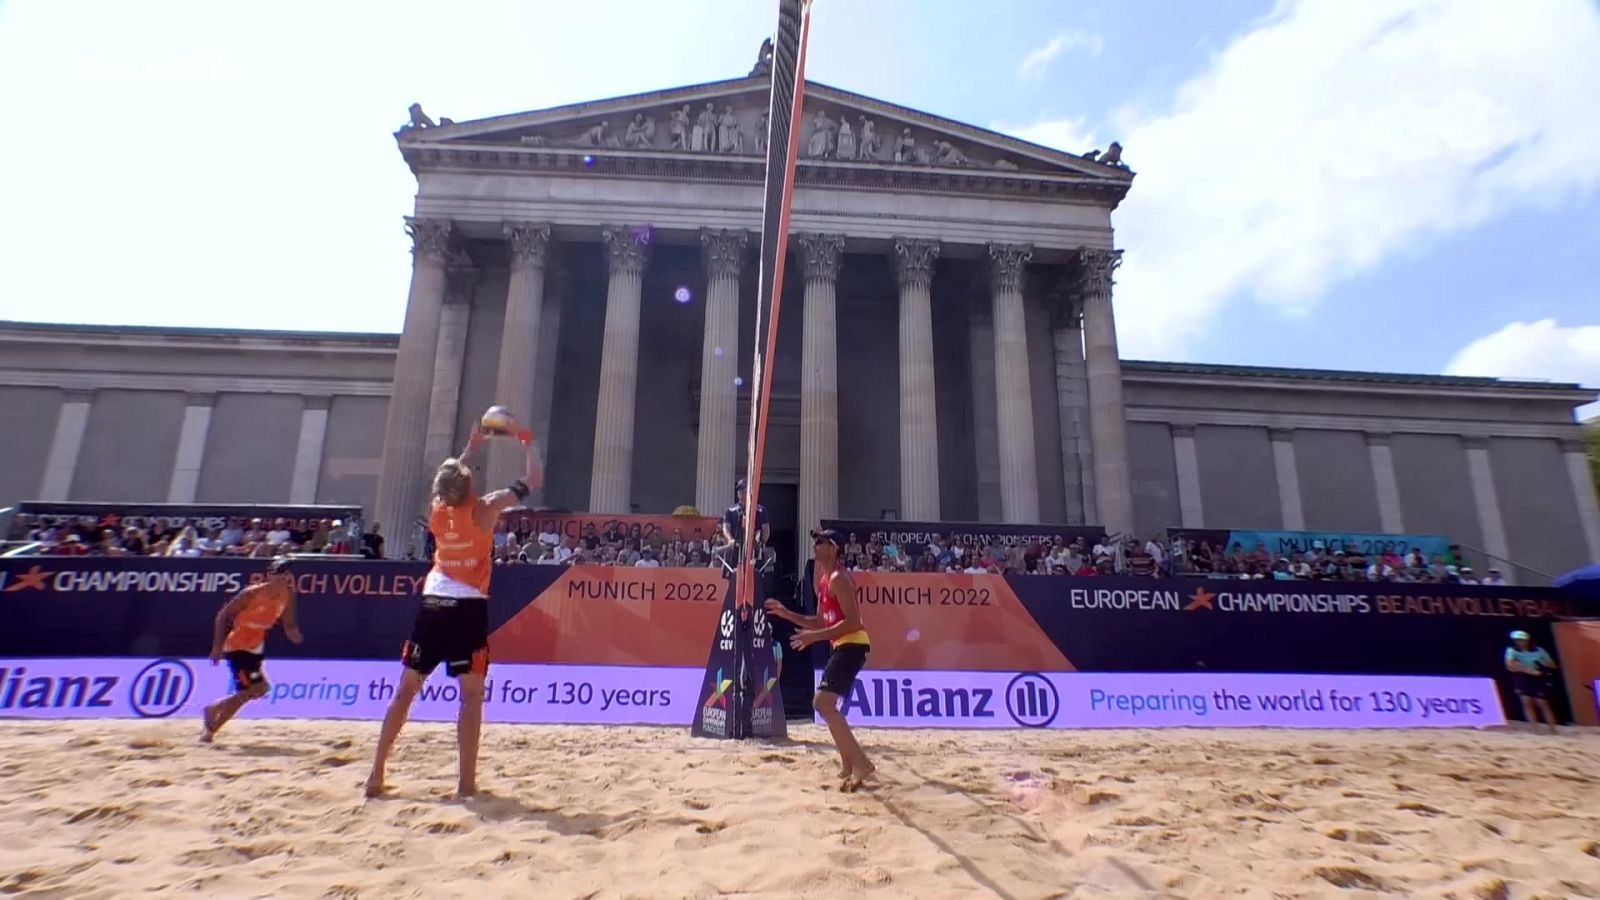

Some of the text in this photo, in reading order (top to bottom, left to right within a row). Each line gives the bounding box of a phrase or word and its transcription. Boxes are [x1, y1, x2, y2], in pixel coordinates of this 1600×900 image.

[54, 570, 242, 592] CHAMPIONSHIPS
[568, 580, 717, 602] MUNICH 2022
[940, 588, 991, 606] 2022
[1070, 589, 1180, 610] EUROPEAN
[1218, 592, 1371, 614] CHAMPIONSHIPS
[1377, 595, 1445, 614] BEACH
[720, 640, 733, 651] CEV
[753, 638, 765, 648] CEV
[502, 680, 538, 704] for
[546, 681, 593, 705] 130
[600, 687, 671, 711] years
[841, 678, 995, 717] Allianz
[1090, 689, 1484, 718] Preparing the world for 130 years
